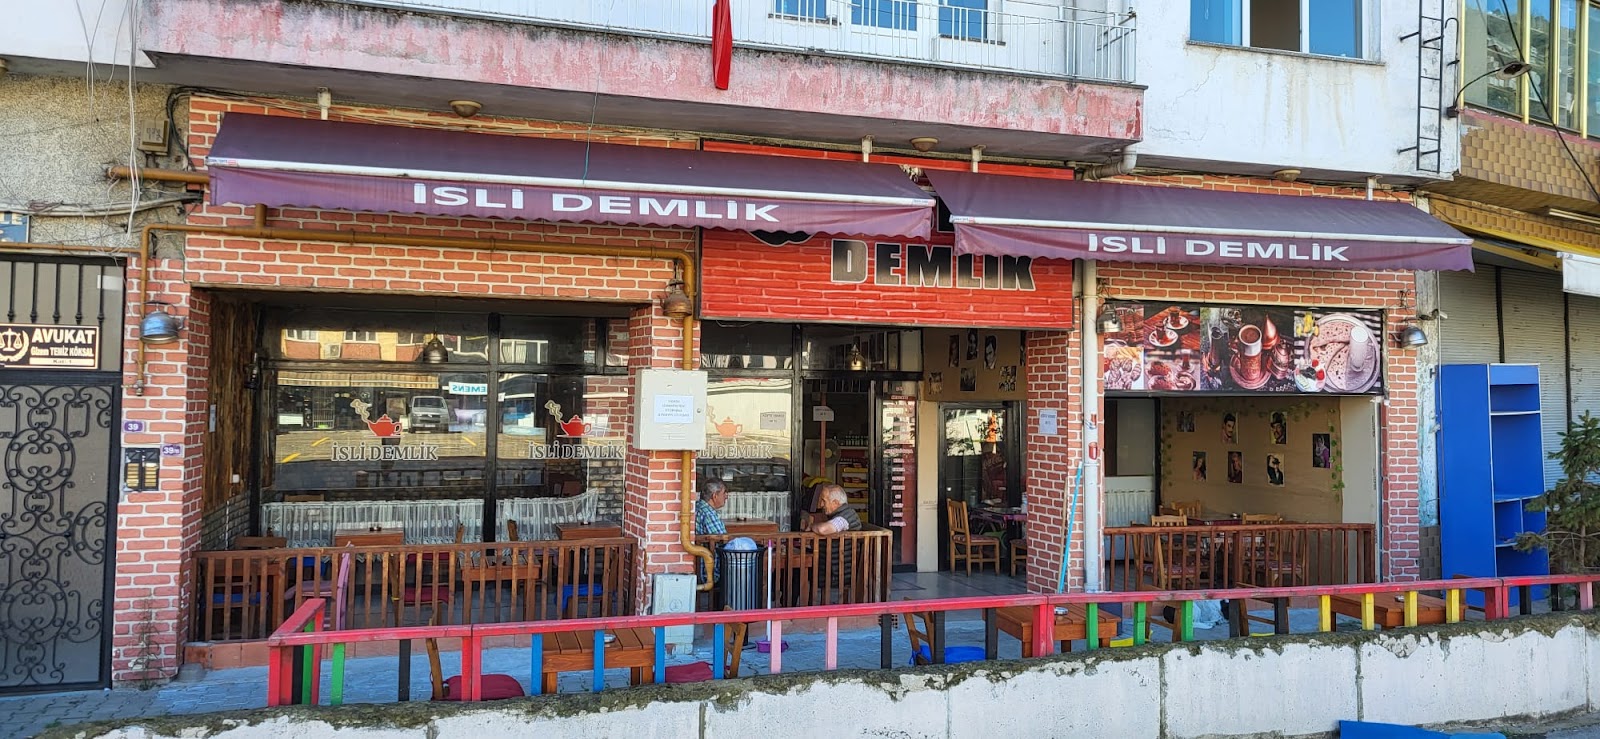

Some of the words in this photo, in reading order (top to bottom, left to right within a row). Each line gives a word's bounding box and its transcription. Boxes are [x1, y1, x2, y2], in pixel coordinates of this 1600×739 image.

[413, 182, 524, 210] İSLİ
[552, 192, 780, 223] DEMLİK
[1088, 232, 1167, 255] İSLİ
[1185, 239, 1350, 262] DEMLİK
[31, 328, 96, 344] AVUKAT
[50, 345, 69, 357] TEMİZ
[70, 346, 94, 357] KÖKSAL
[331, 441, 368, 462] İSLİ
[370, 441, 438, 462] DEMLİK
[528, 441, 562, 462] İSLİ
[563, 441, 625, 462] DEMLİK
[716, 441, 773, 459] DEMLİK
